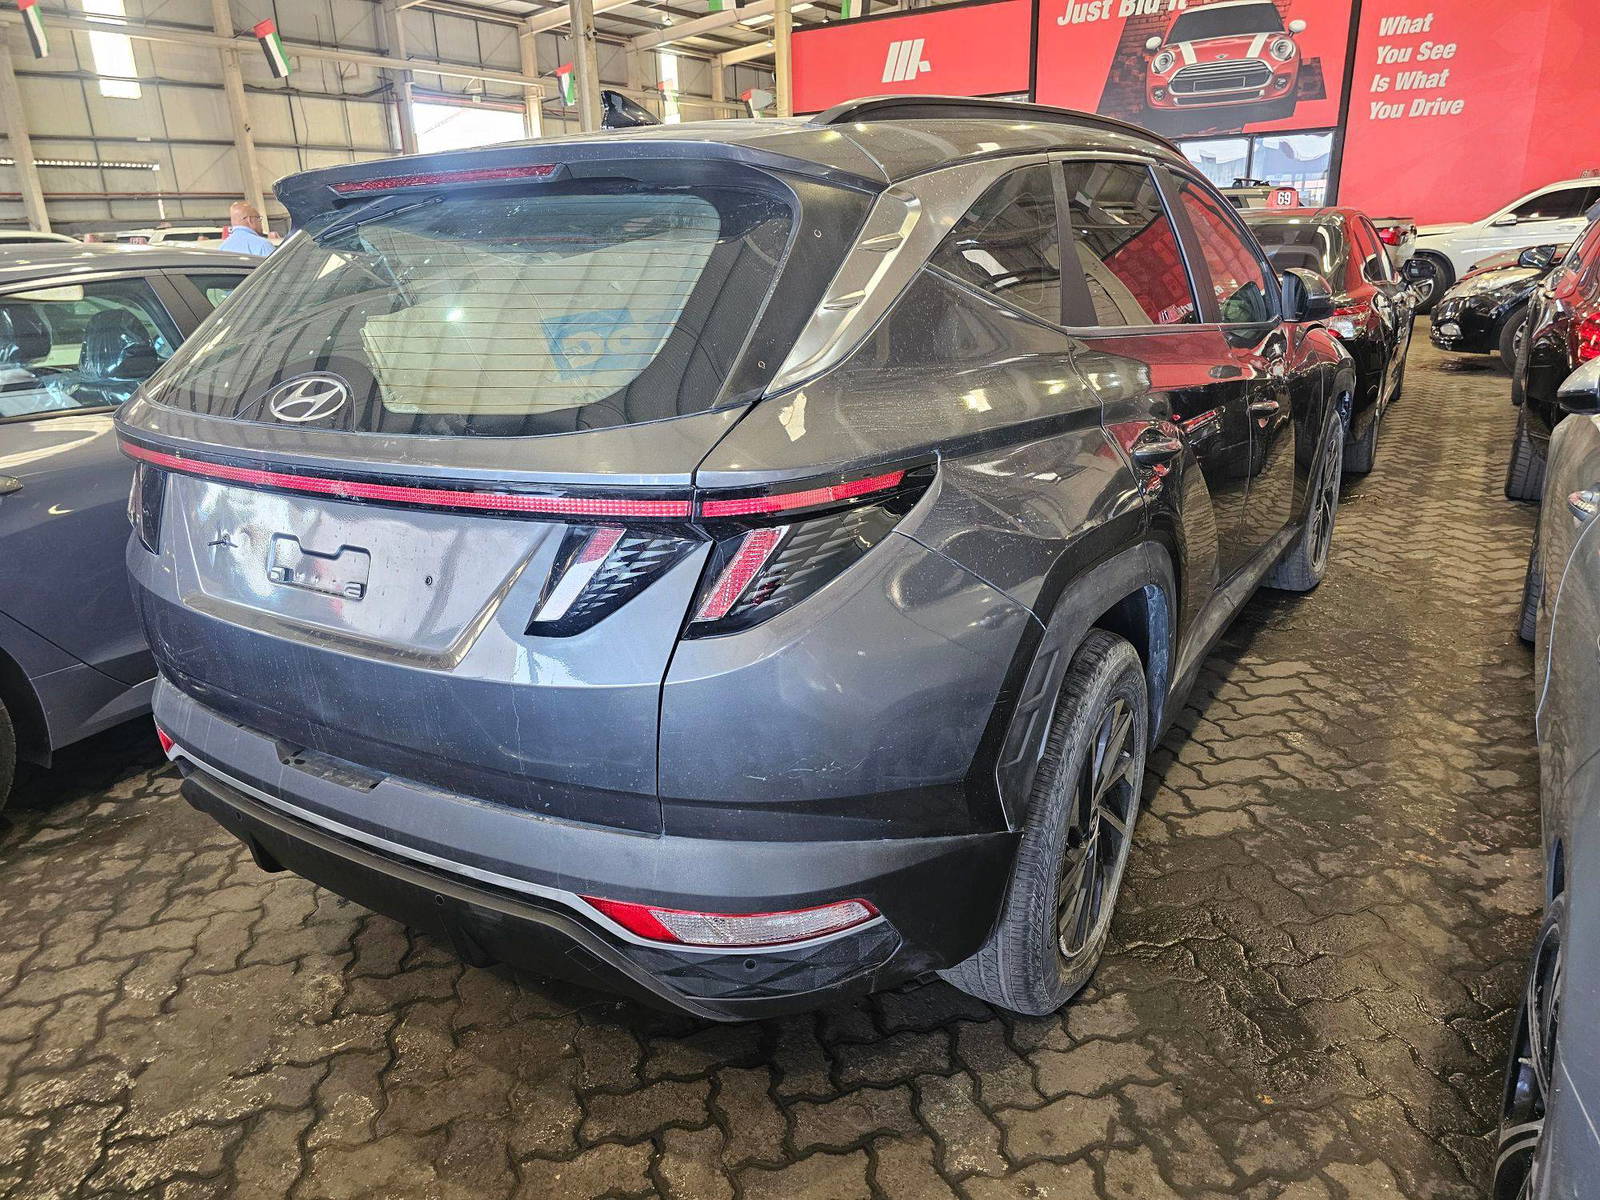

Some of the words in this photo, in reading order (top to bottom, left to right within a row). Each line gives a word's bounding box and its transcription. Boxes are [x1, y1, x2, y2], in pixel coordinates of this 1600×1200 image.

[1057, 0, 1112, 26] Just
[1379, 12, 1434, 37] What
[1376, 45, 1413, 65] You
[1416, 41, 1457, 61] See
[1369, 74, 1391, 93] Is
[1394, 68, 1450, 91] What
[1369, 101, 1406, 120] You
[1408, 97, 1465, 118] Drive
[1277, 191, 1291, 205] 69
